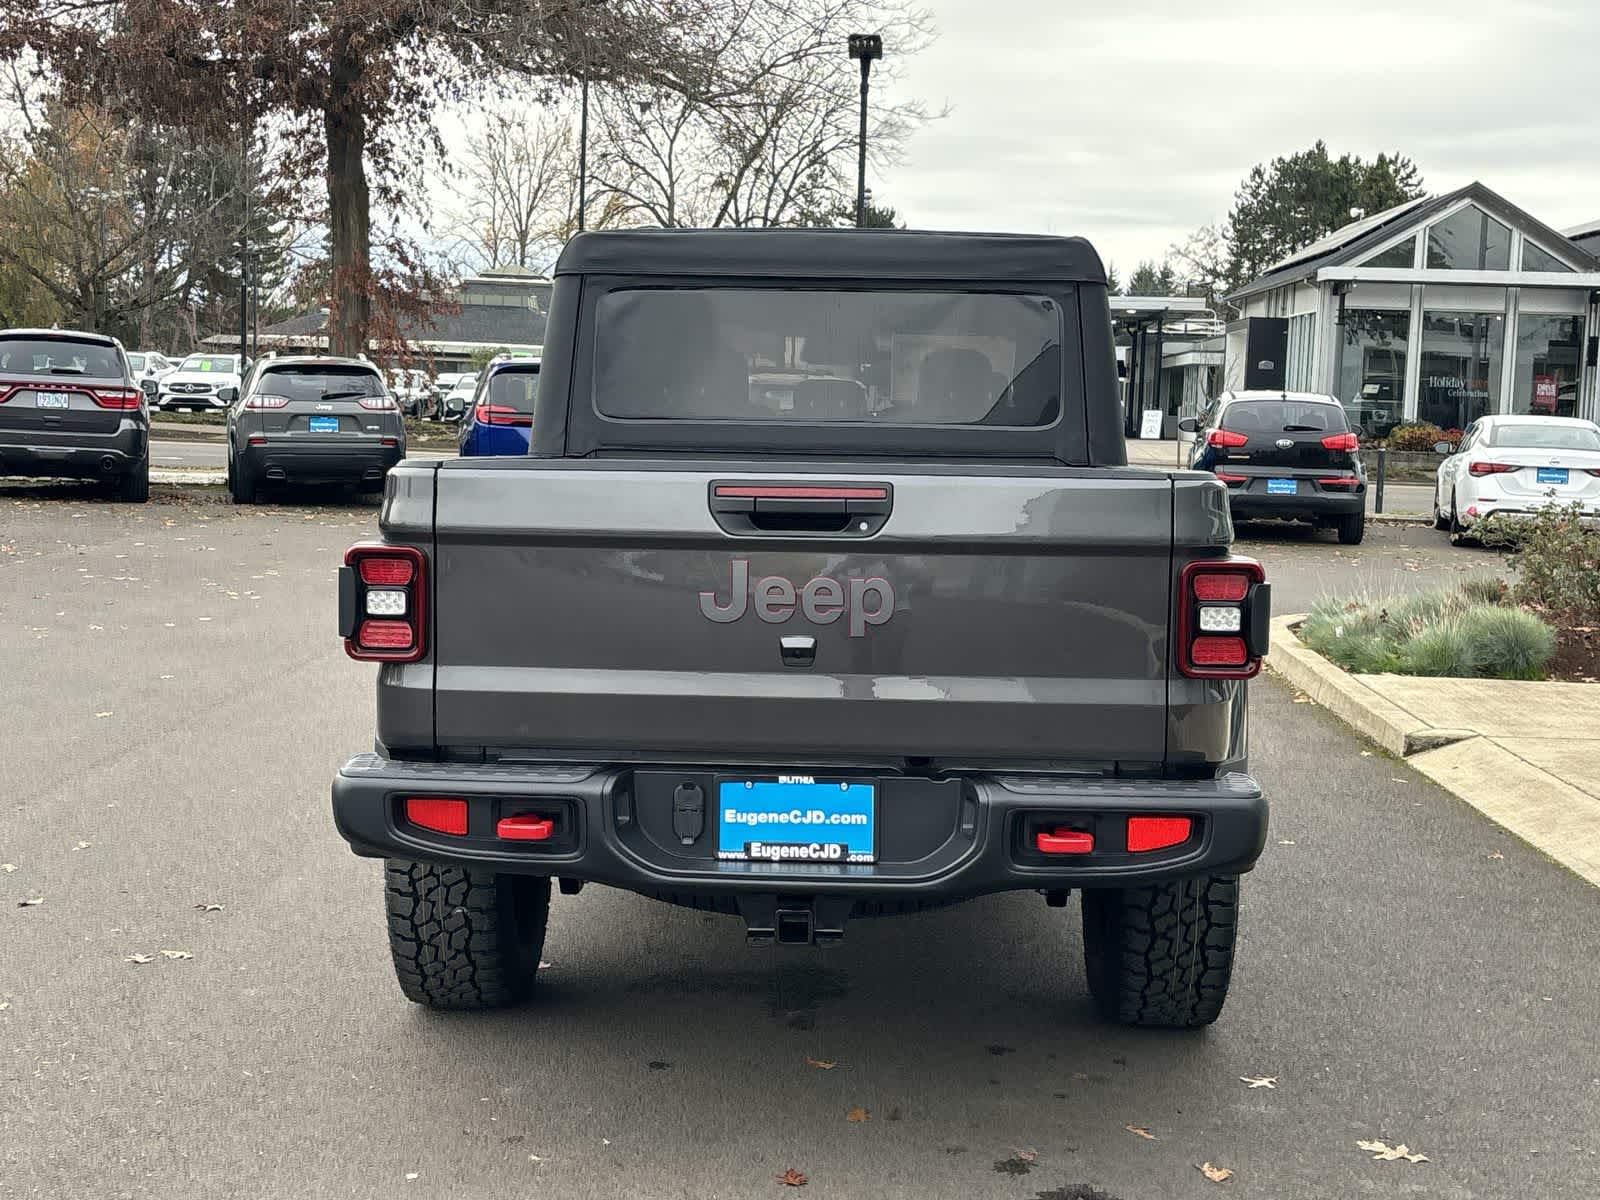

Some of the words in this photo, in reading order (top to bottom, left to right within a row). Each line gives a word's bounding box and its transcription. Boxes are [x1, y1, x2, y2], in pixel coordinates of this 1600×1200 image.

[1429, 375, 1466, 390] Holiday
[1447, 389, 1489, 398] Celebration
[699, 557, 896, 638] Jeep
[787, 775, 815, 785] LITHIA
[724, 808, 868, 826] EugeneCJD.com
[718, 851, 748, 860] www.
[750, 842, 842, 861] EugeneCJD
[846, 852, 874, 862] .com
